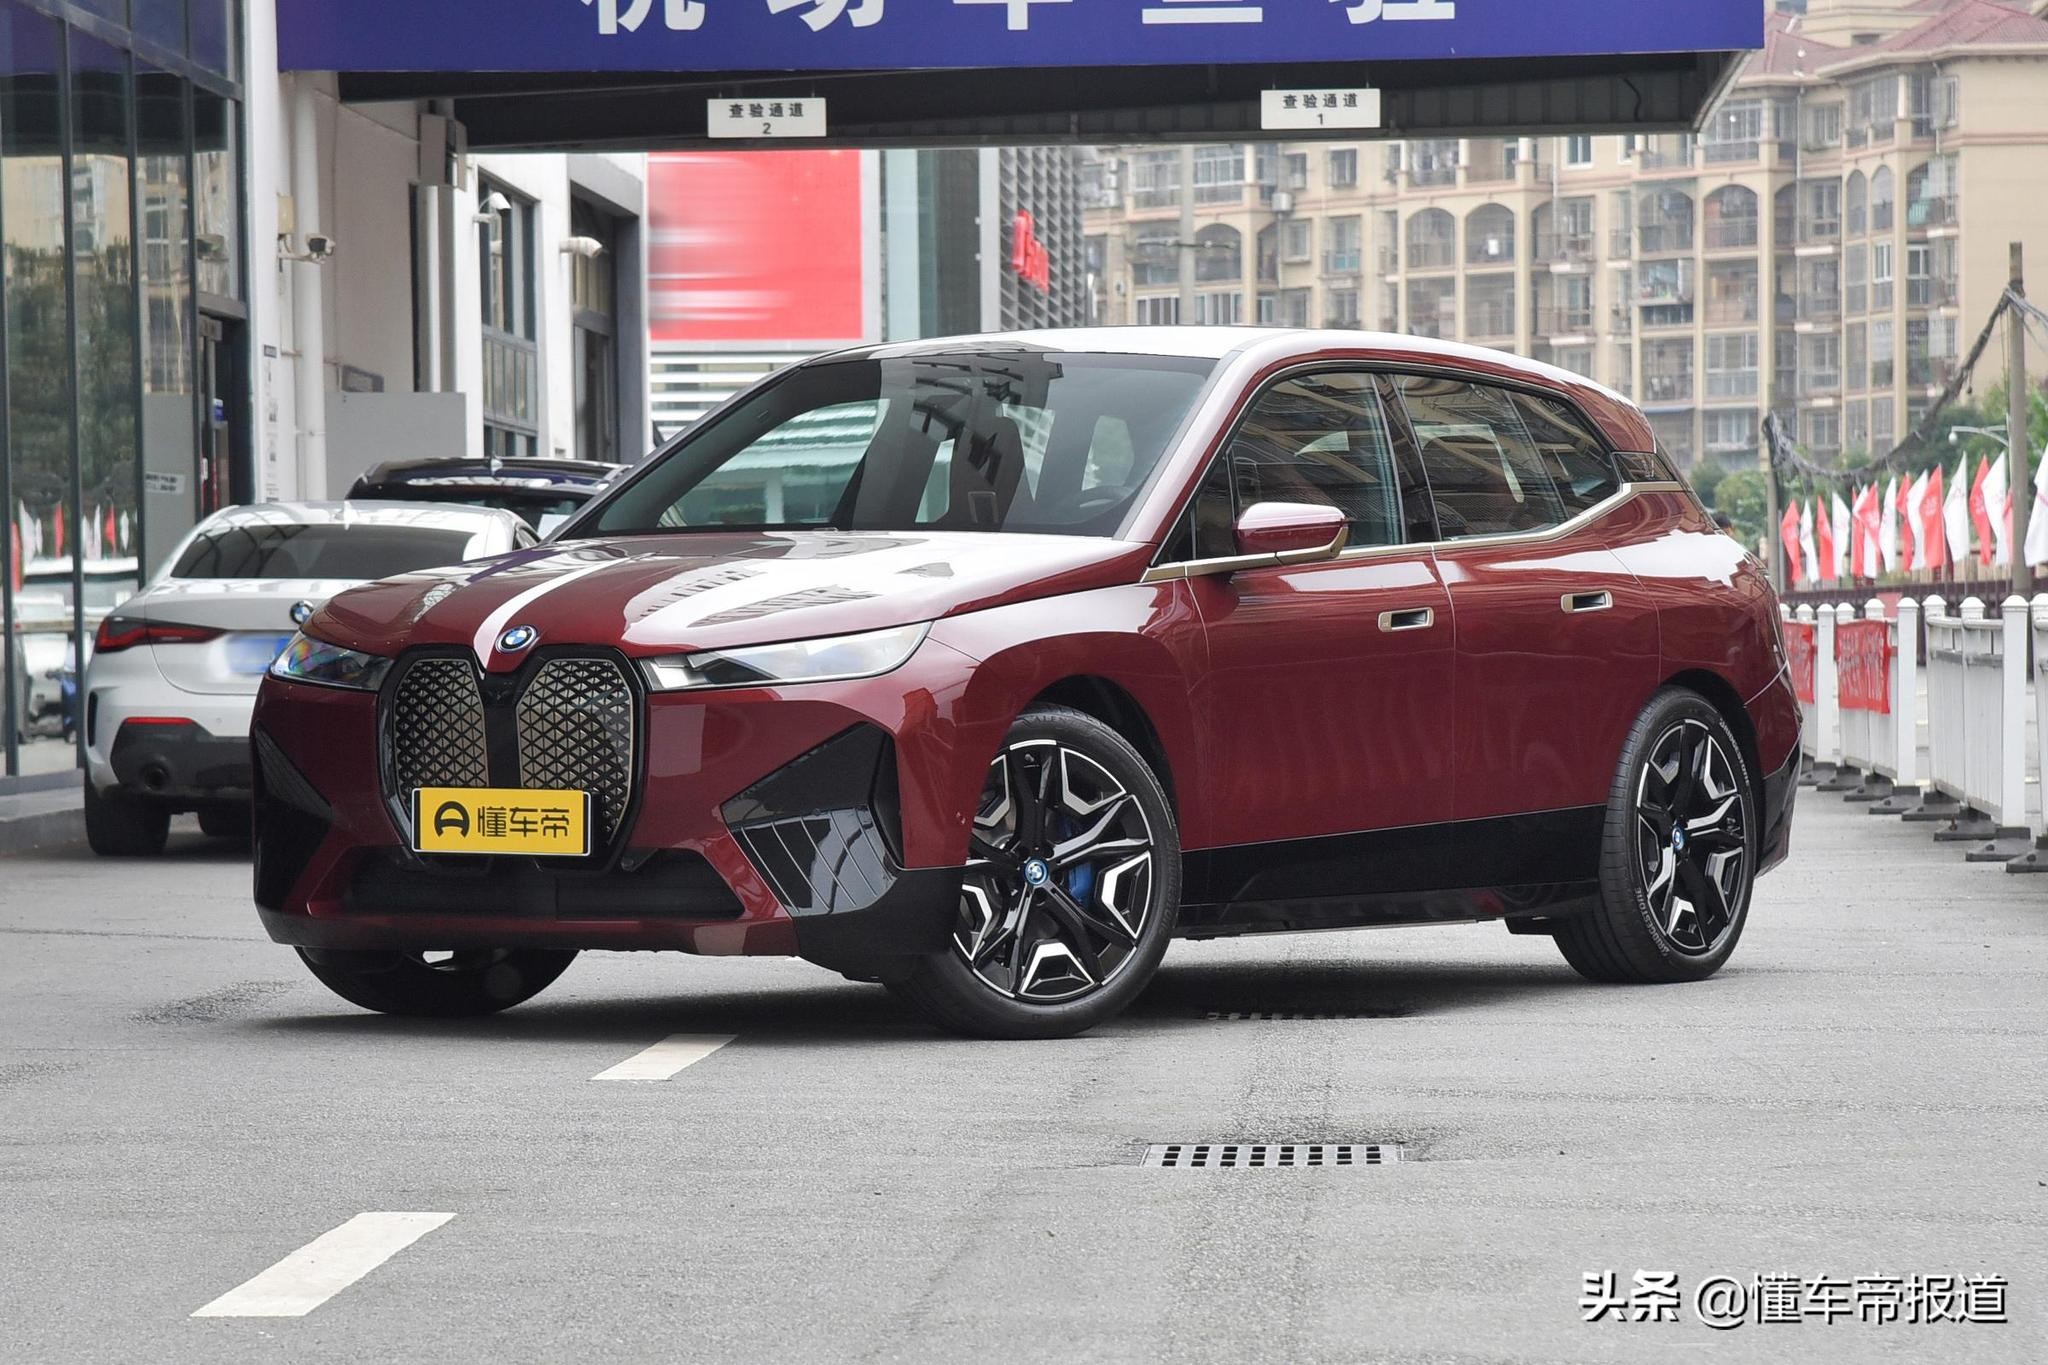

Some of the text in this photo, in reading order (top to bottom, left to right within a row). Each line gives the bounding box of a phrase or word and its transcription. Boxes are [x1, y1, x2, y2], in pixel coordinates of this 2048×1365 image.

[1283, 93, 1358, 109] 查验通道
[729, 103, 804, 118] 查验通道
[1317, 113, 1324, 125] 1
[762, 122, 772, 135] 2
[477, 806, 570, 838] 懂车帝
